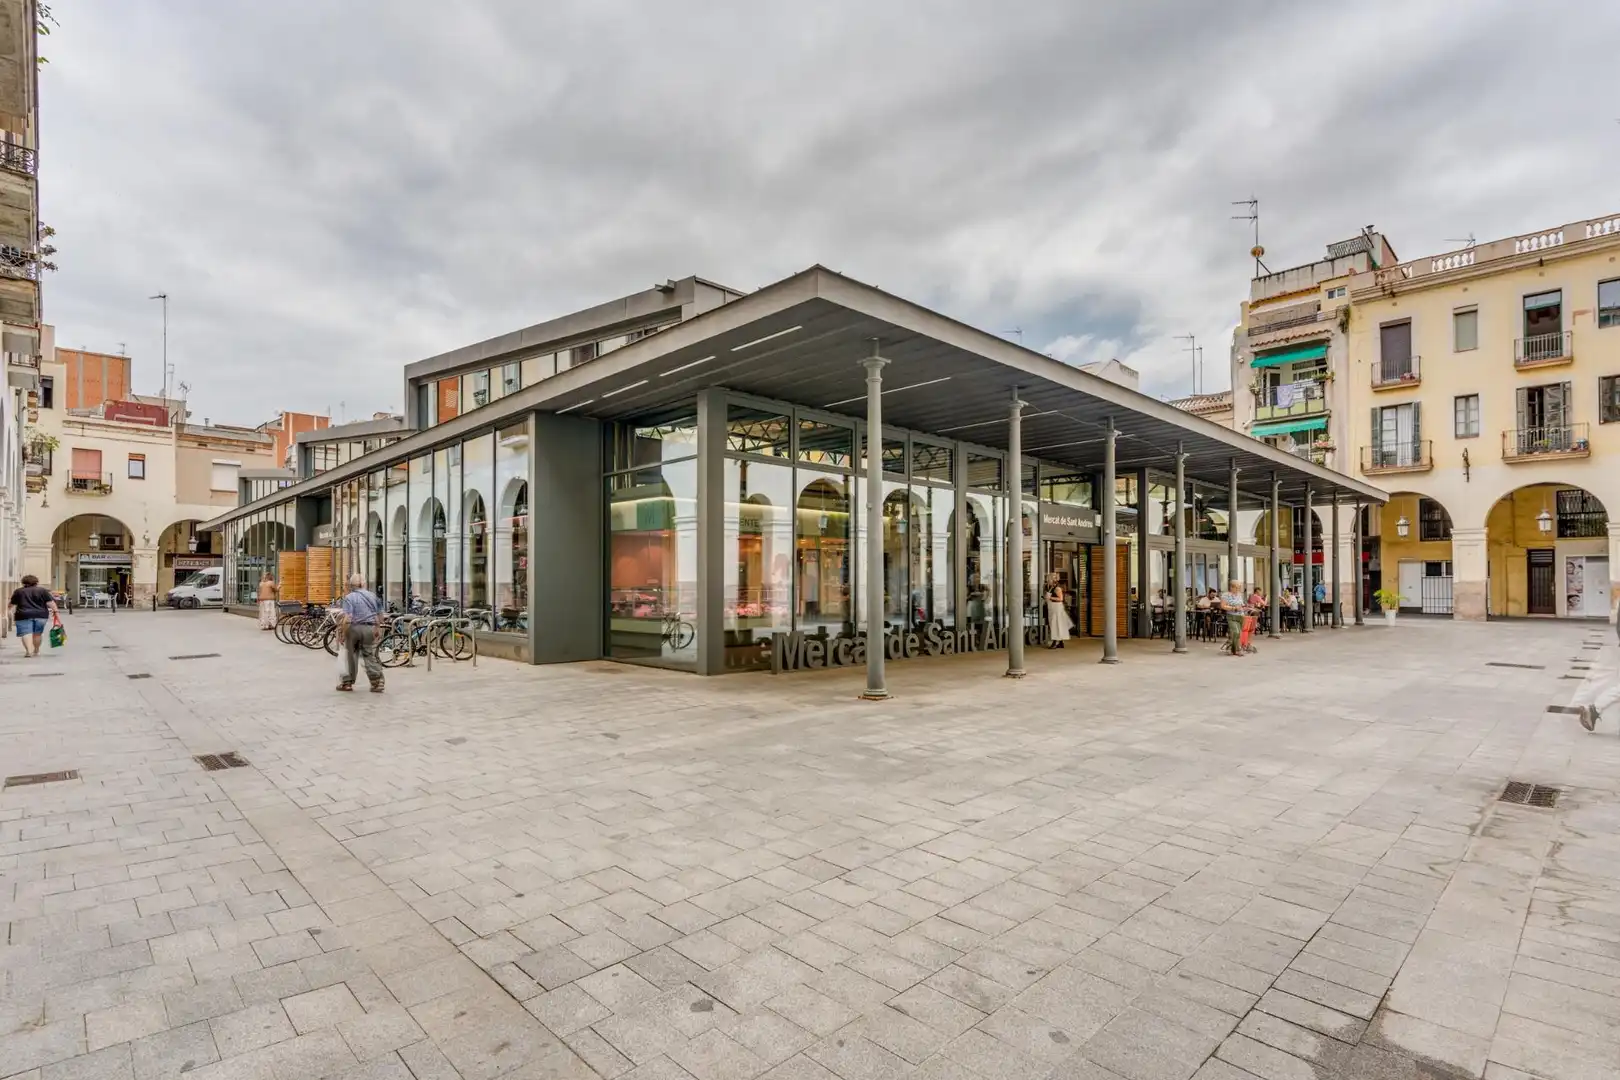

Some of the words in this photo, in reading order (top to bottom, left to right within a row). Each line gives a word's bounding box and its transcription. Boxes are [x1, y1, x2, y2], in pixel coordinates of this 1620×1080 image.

[1043, 513, 1060, 524] Mercat
[1061, 516, 1067, 525] de
[1067, 516, 1078, 527] Sant
[1078, 518, 1093, 528] Andreu
[772, 631, 868, 673] Merca
[885, 625, 920, 660] de
[924, 621, 978, 657] Sant
